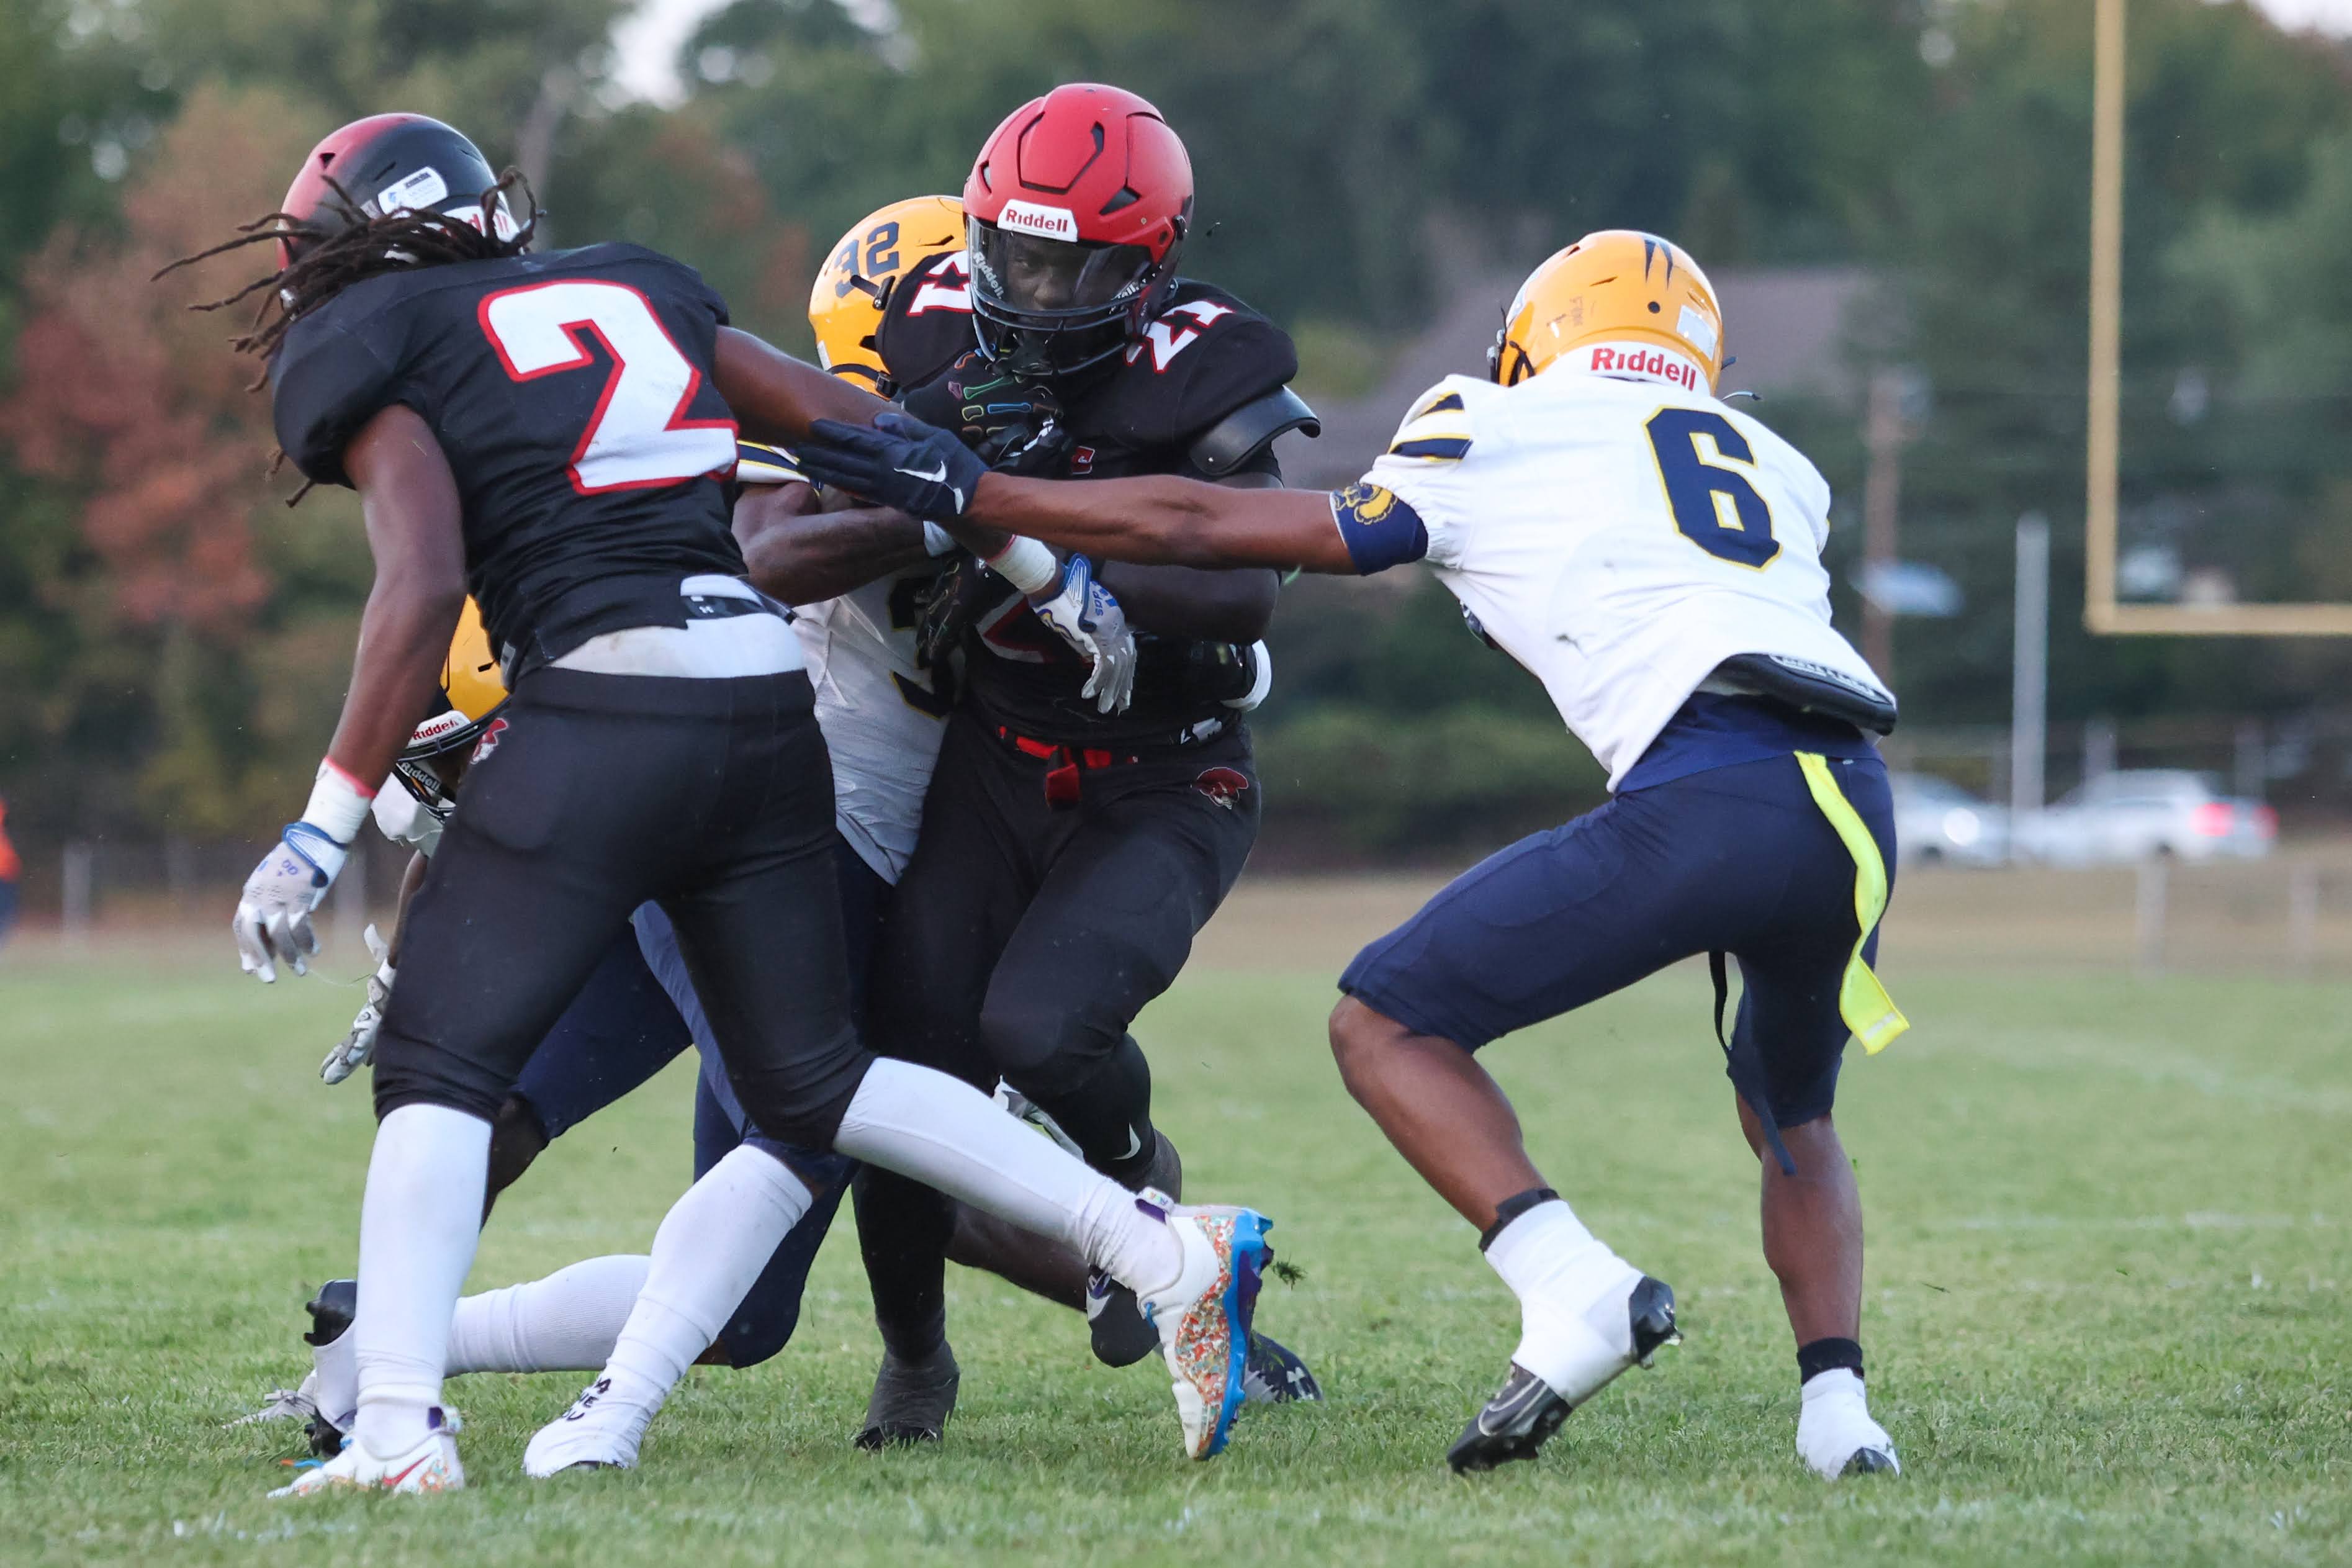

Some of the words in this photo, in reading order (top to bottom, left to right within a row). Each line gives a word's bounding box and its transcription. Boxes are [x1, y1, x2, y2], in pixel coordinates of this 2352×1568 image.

[1005, 209, 1068, 233] Riddell
[478, 279, 739, 495] 2
[1591, 348, 1696, 391] Riddell
[1642, 405, 1783, 573] 6
